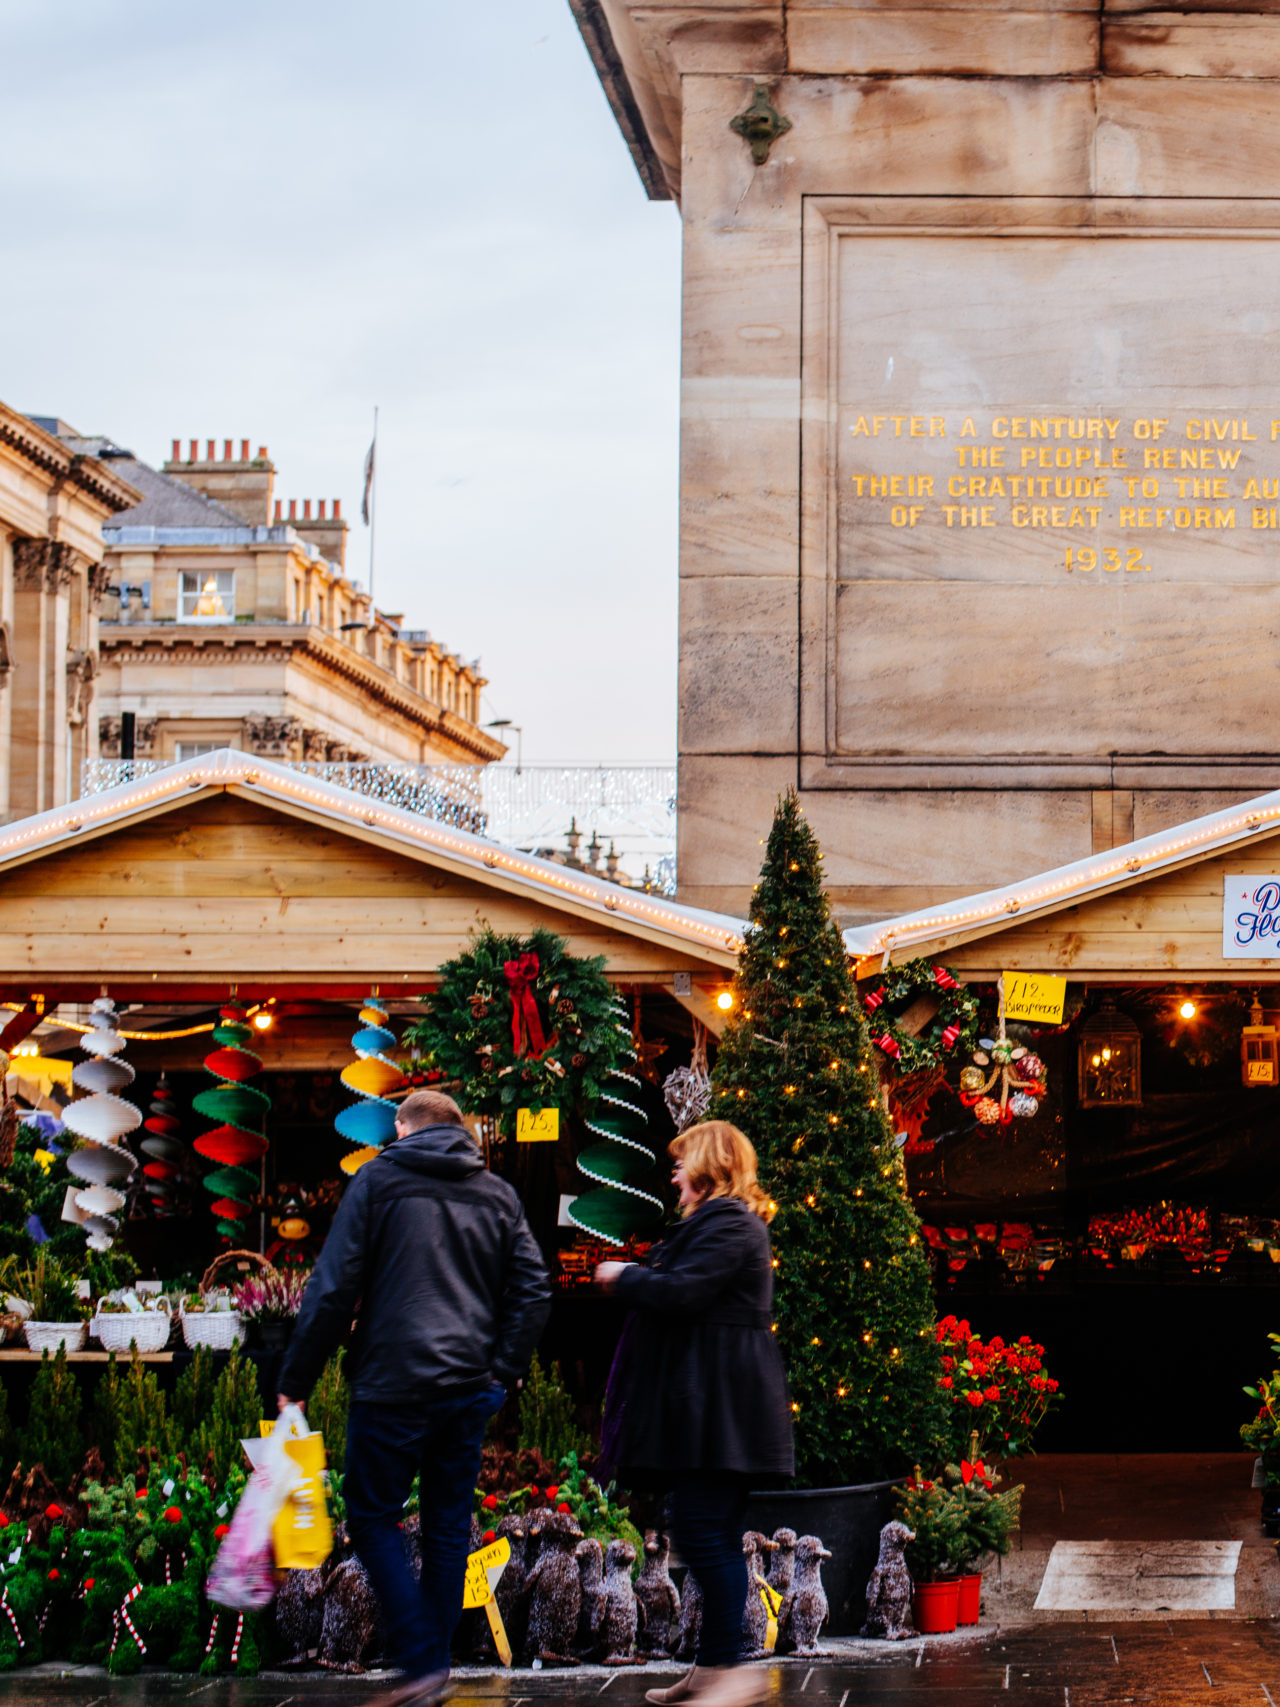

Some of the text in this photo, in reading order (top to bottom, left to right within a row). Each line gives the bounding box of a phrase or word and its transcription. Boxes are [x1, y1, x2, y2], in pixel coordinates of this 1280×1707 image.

[853, 416, 947, 438] AFTER
[960, 418, 978, 438] A
[993, 418, 1121, 440] CENTURY
[1134, 419, 1170, 440] OF
[1187, 420, 1258, 442] CIVIL
[954, 446, 1242, 470] THE PEOPLE RENEW
[853, 474, 935, 498] THEIR
[948, 475, 1110, 499] GRATITUDE
[1125, 477, 1160, 499] TO
[1175, 477, 1230, 499] THE
[891, 504, 926, 528] OF
[942, 505, 997, 528] THE
[1012, 505, 1103, 529] GREAT
[1120, 507, 1237, 530] REFORM
[1065, 547, 1153, 573] 1932.
